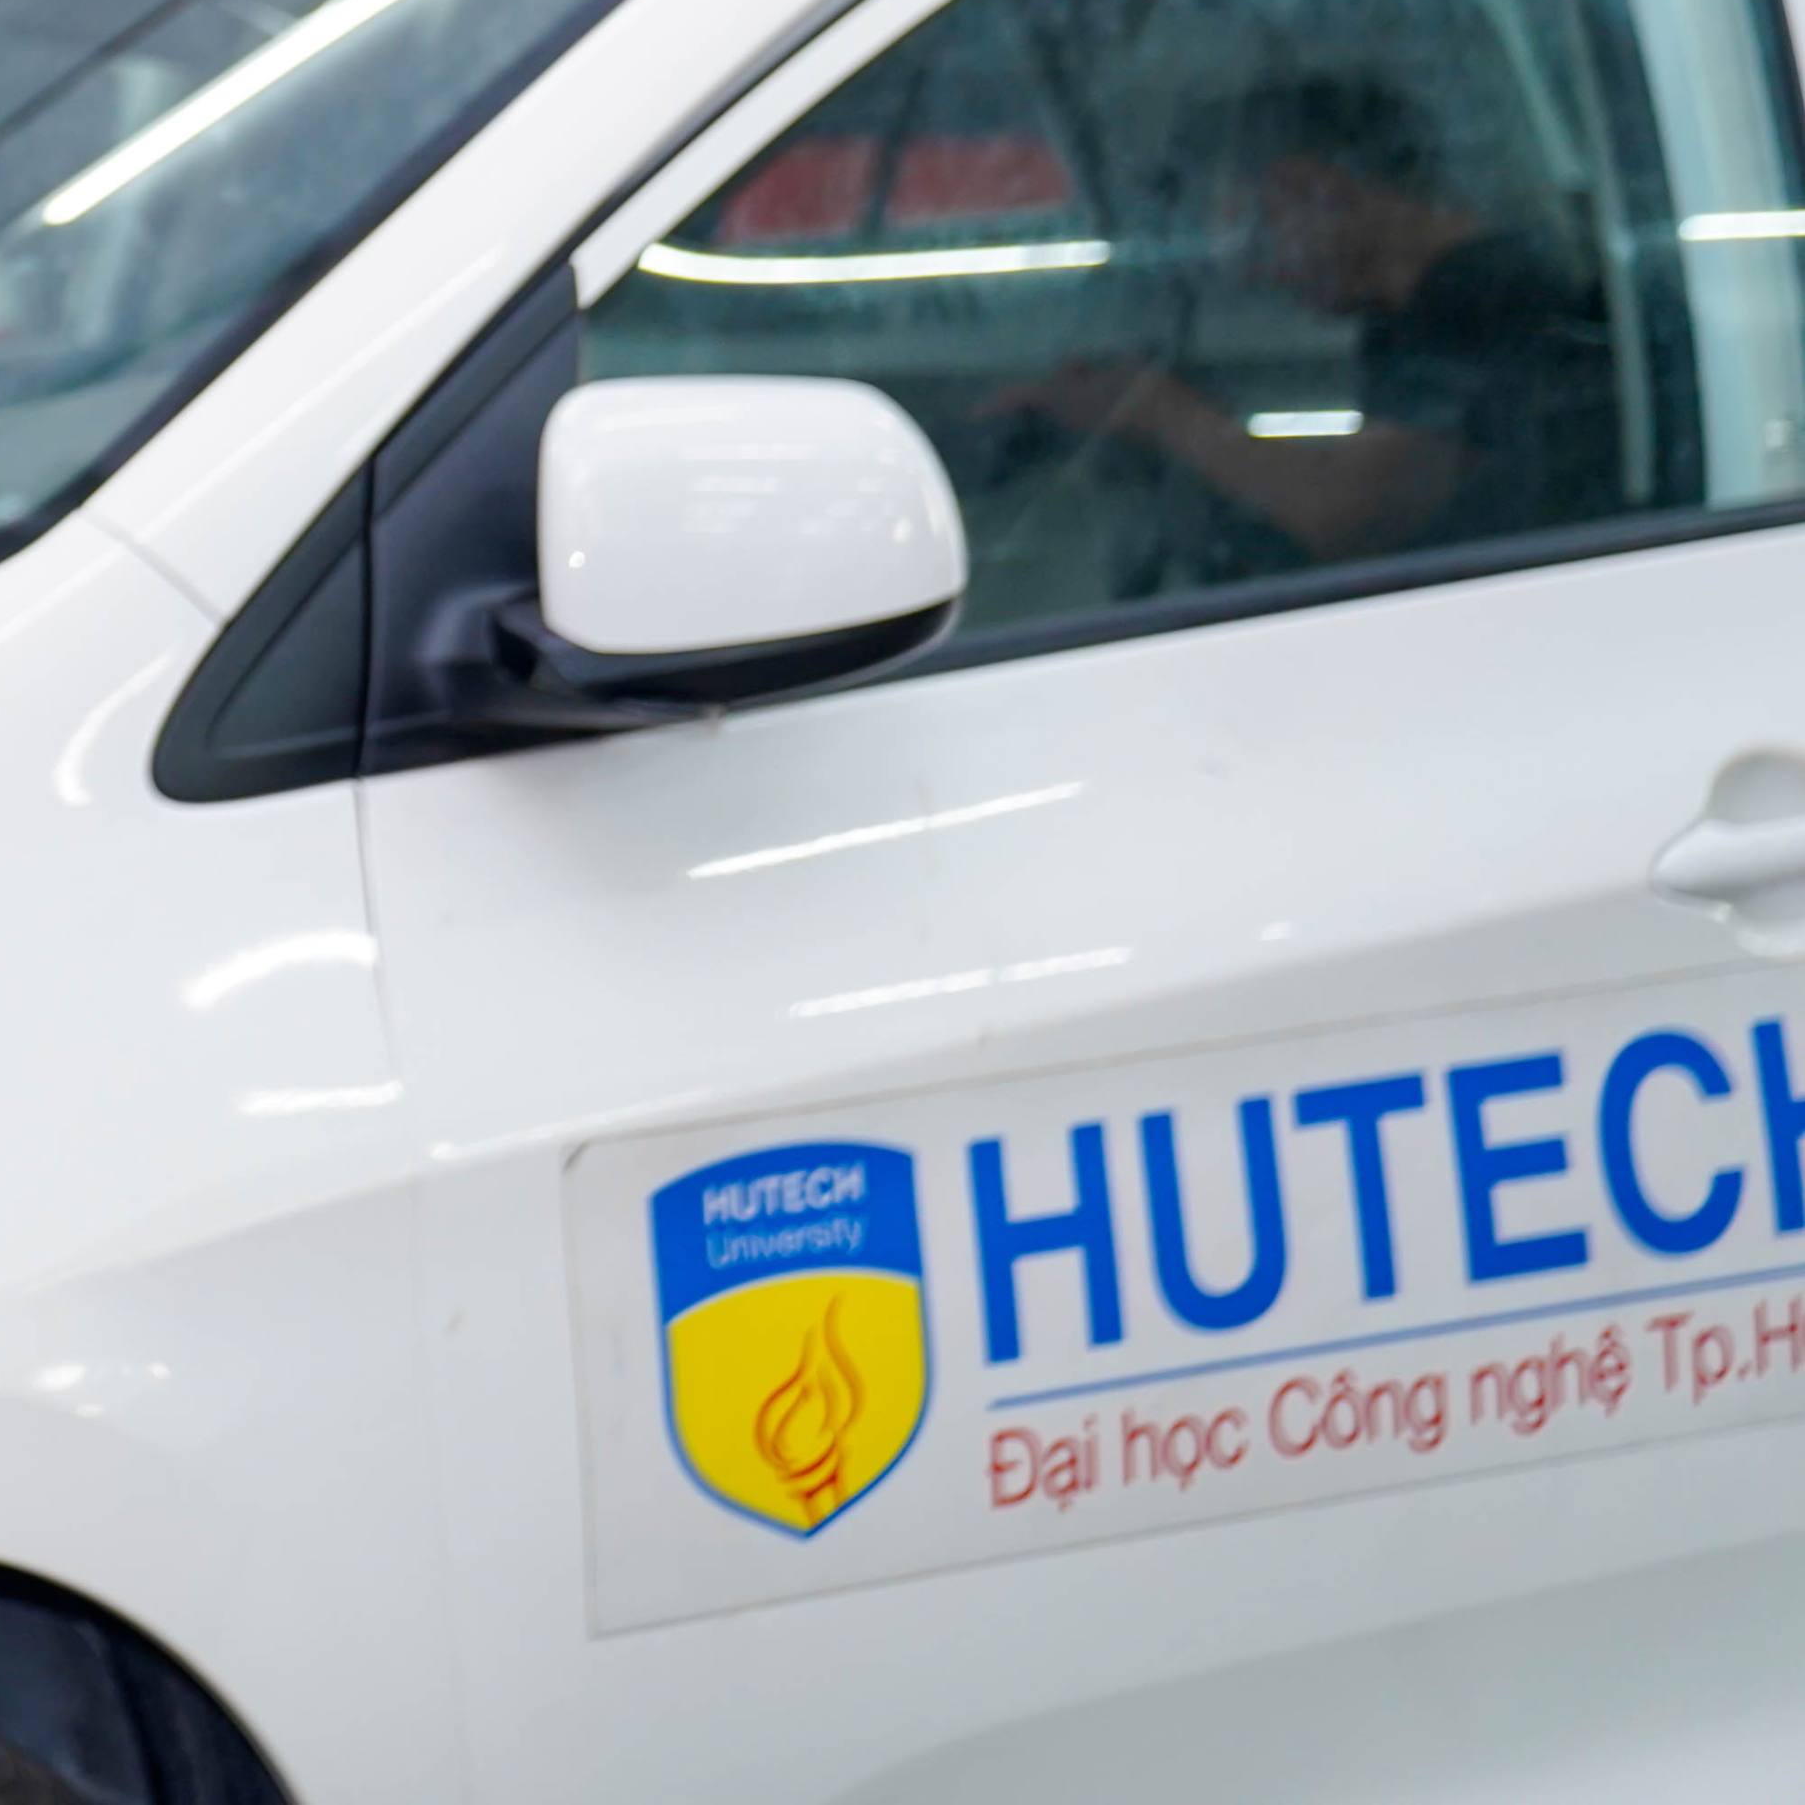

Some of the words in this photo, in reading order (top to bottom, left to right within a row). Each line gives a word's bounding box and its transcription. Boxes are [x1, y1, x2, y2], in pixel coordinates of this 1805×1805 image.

[703, 1161, 865, 1226] HUTECH
[706, 1217, 863, 1269] University
[986, 1412, 1100, 1513] Đại
[1120, 1407, 1250, 1492] học
[1267, 1368, 1449, 1454] Công
[1469, 1323, 1633, 1437] nghệ
